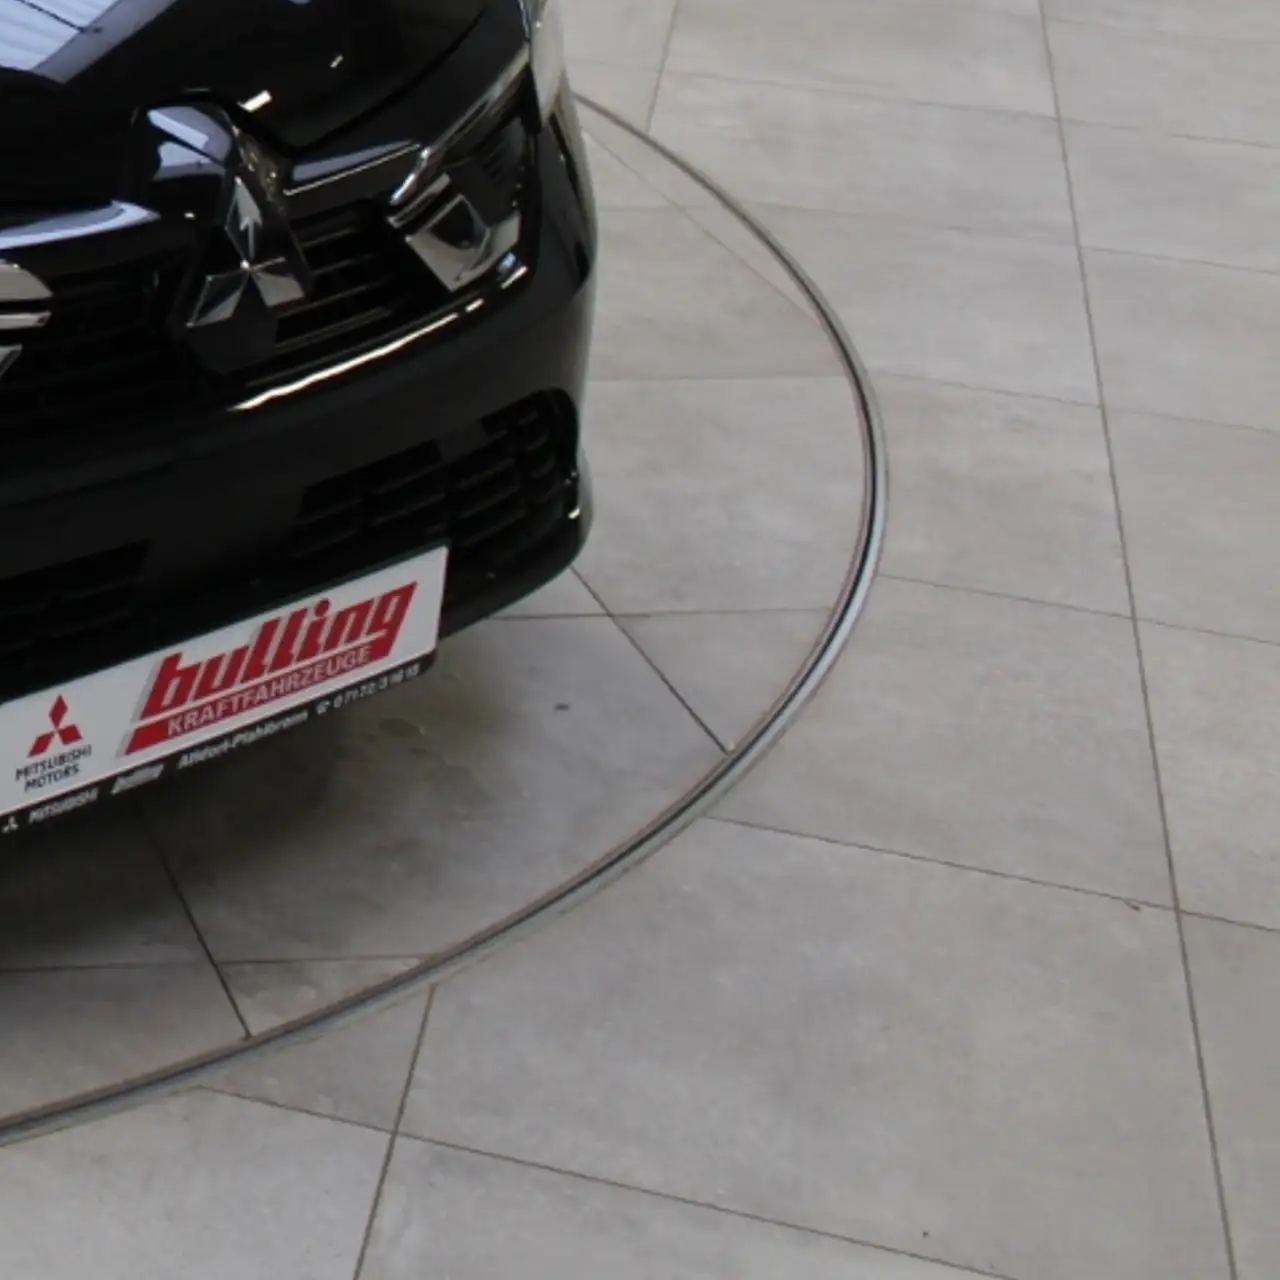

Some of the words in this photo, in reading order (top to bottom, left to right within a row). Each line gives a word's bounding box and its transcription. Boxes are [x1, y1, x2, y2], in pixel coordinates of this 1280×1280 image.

[140, 581, 418, 720] bulling
[167, 645, 372, 737] KRAFTFAHRZEUGE
[15, 744, 92, 781] MITSUBISHI
[24, 764, 80, 792] MOTORS
